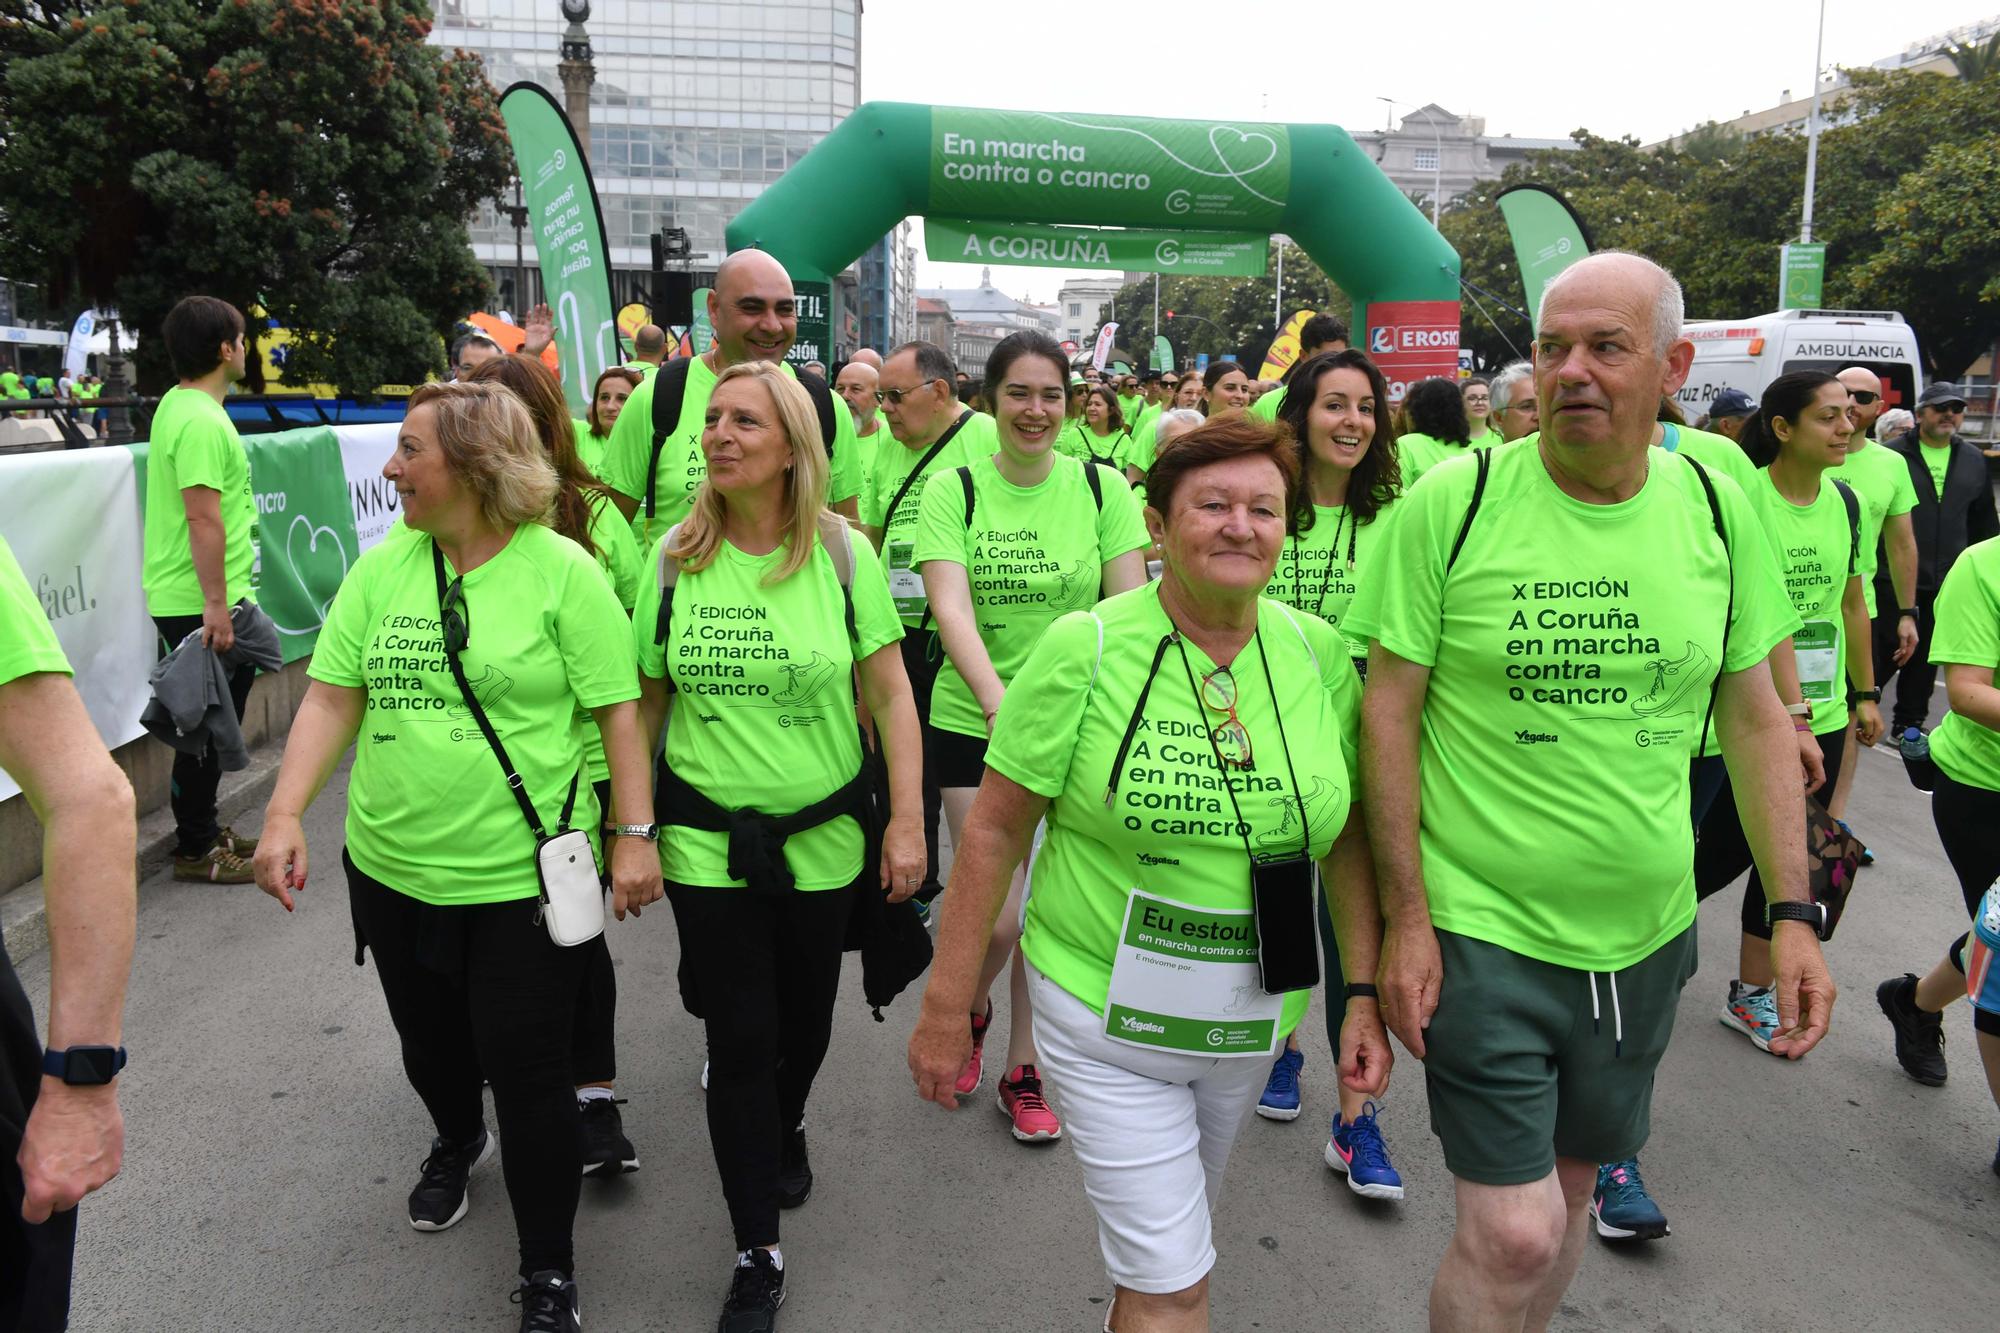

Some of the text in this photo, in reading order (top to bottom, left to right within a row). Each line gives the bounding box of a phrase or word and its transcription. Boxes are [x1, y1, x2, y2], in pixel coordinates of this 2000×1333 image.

[944, 133, 1086, 162] En marcha
[943, 160, 1151, 190] contra o cancro
[962, 234, 1112, 264] A CORUÑA
[1795, 344, 1905, 359] AMBULANCIA
[1677, 387, 1699, 402] ruz
[689, 434, 697, 445] X
[688, 450, 698, 463] A
[253, 491, 286, 514] ncro
[976, 528, 1038, 543] X EDICIÓN
[974, 546, 1045, 559] A Coruña
[973, 560, 1060, 576] en marcha
[1784, 561, 1822, 574] ruña
[974, 577, 1028, 590] contra
[1266, 581, 1355, 595] en marcha
[1512, 576, 1629, 600] X EDICIÓN
[37, 565, 97, 621] fael.
[977, 592, 1046, 606] o cancro
[689, 603, 767, 620] X EDICIÓN
[1508, 607, 1640, 631] A Coruña
[682, 624, 774, 642] A Coruña
[371, 635, 446, 653] A Coruñ
[679, 644, 790, 660] en marcha
[1506, 633, 1661, 655] en marcha
[367, 656, 451, 673] en march
[677, 661, 745, 678] contra
[1505, 659, 1601, 680] contra
[682, 682, 769, 696] o cancro
[1509, 686, 1628, 704] o cancro
[368, 696, 446, 710] o cancro
[1137, 716, 1151, 731] X
[1514, 729, 1558, 744] Vegalsa
[1132, 740, 1257, 773] A Coruña
[1129, 767, 1284, 793] en marcha
[1125, 790, 1222, 814] contra
[1124, 815, 1253, 837] o cancro
[1136, 852, 1180, 866] Vegalsa
[1142, 906, 1249, 941] Eu estou
[1138, 933, 1153, 943] en
[1154, 936, 1198, 953] marcha
[1200, 945, 1235, 956] contra
[1135, 953, 1141, 961] E
[1142, 956, 1177, 969] móvome
[1120, 1015, 1165, 1034] Vegalsa
